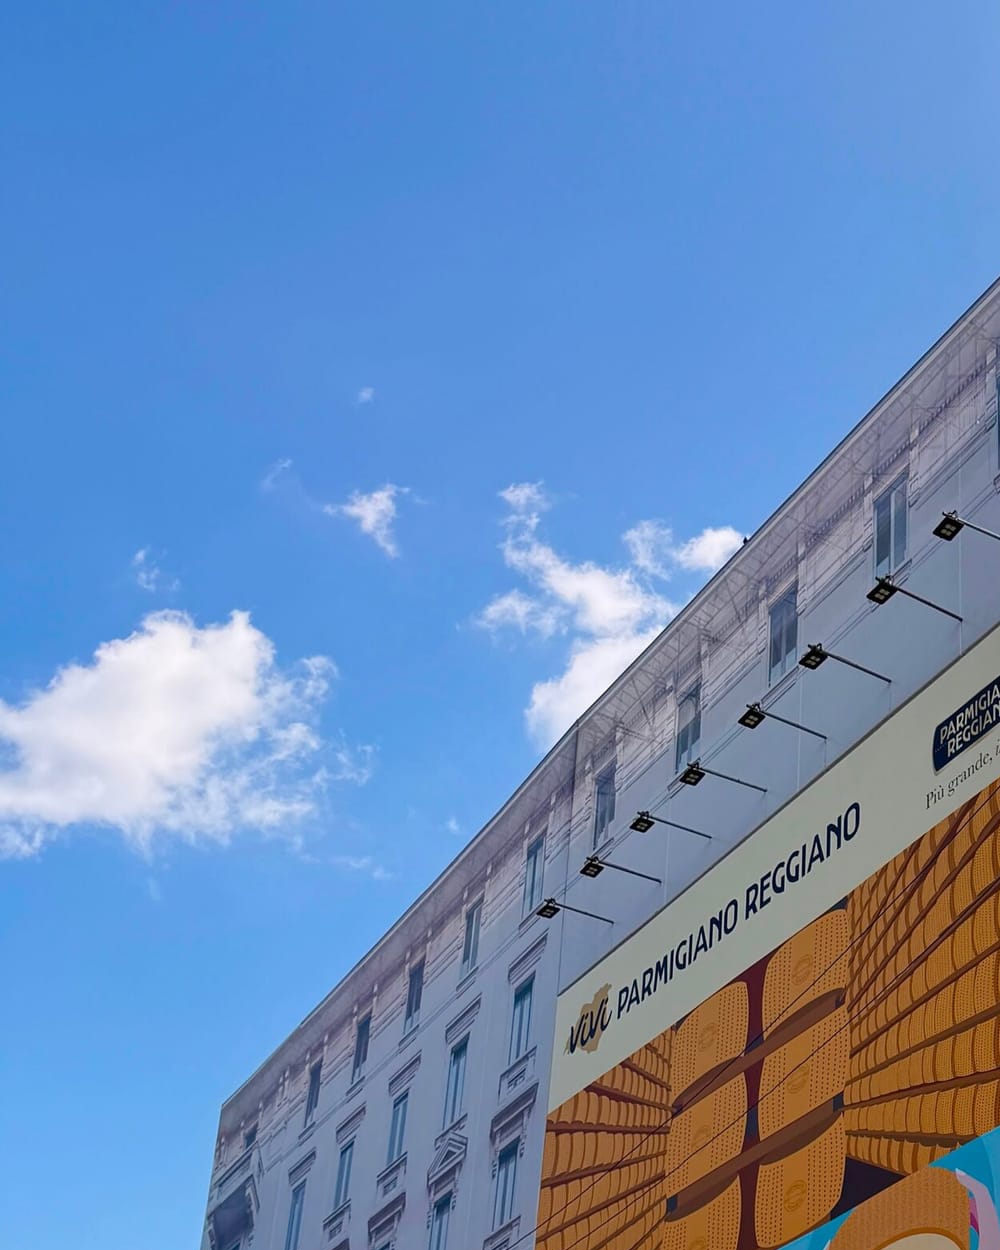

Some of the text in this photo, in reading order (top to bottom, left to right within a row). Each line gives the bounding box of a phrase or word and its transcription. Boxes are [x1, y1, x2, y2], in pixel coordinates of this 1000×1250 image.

[925, 786, 944, 809] Più
[947, 753, 994, 798] grande,
[617, 898, 739, 1020] PARMIGIANO
[745, 801, 861, 920] REGGIANO
